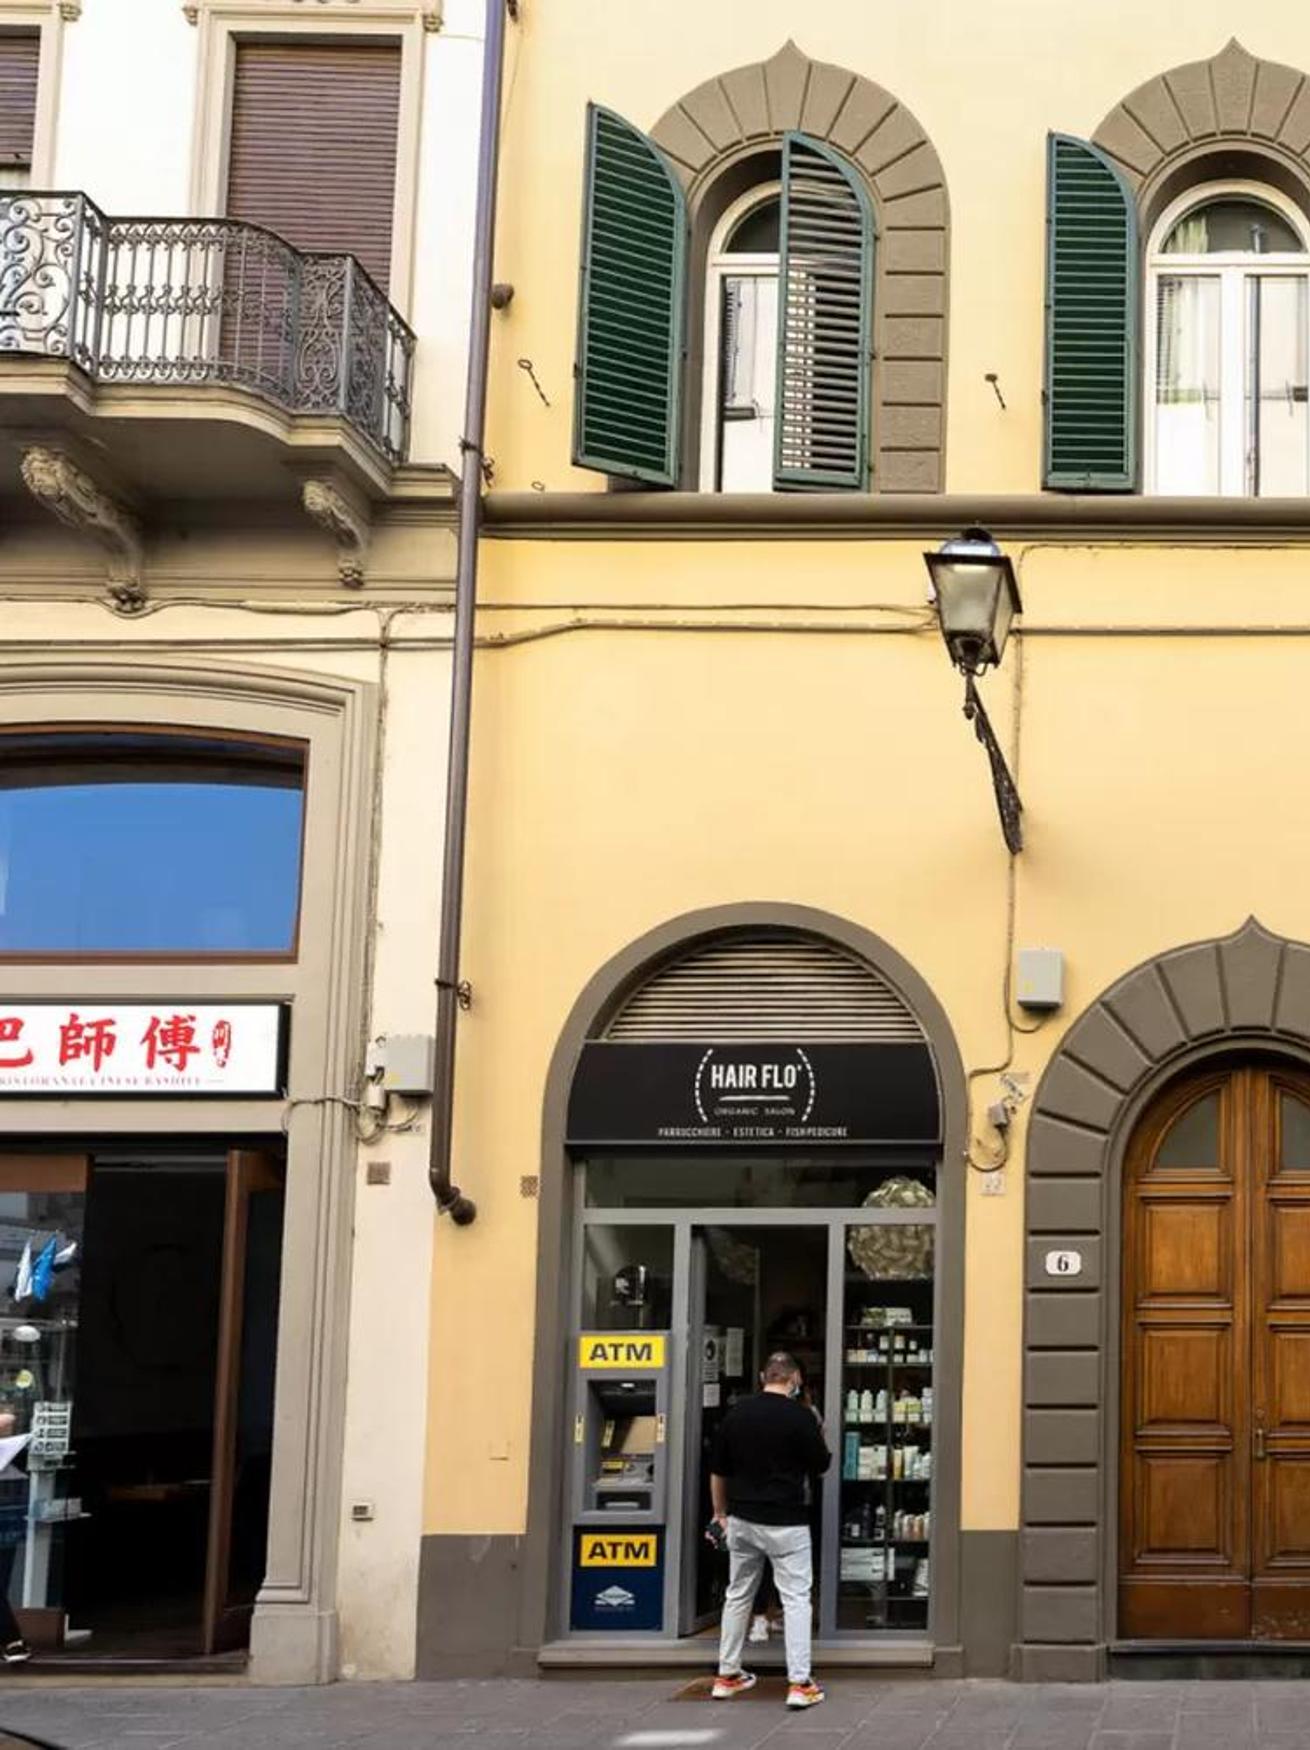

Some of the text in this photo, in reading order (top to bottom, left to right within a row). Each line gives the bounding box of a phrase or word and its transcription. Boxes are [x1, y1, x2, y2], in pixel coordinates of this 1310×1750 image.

[711, 1064, 757, 1089] HAIR
[733, 1127, 775, 1137] ESTETICA
[1057, 1254, 1070, 1273] 6
[589, 1343, 653, 1361] ATM
[588, 1541, 650, 1560] ATM
